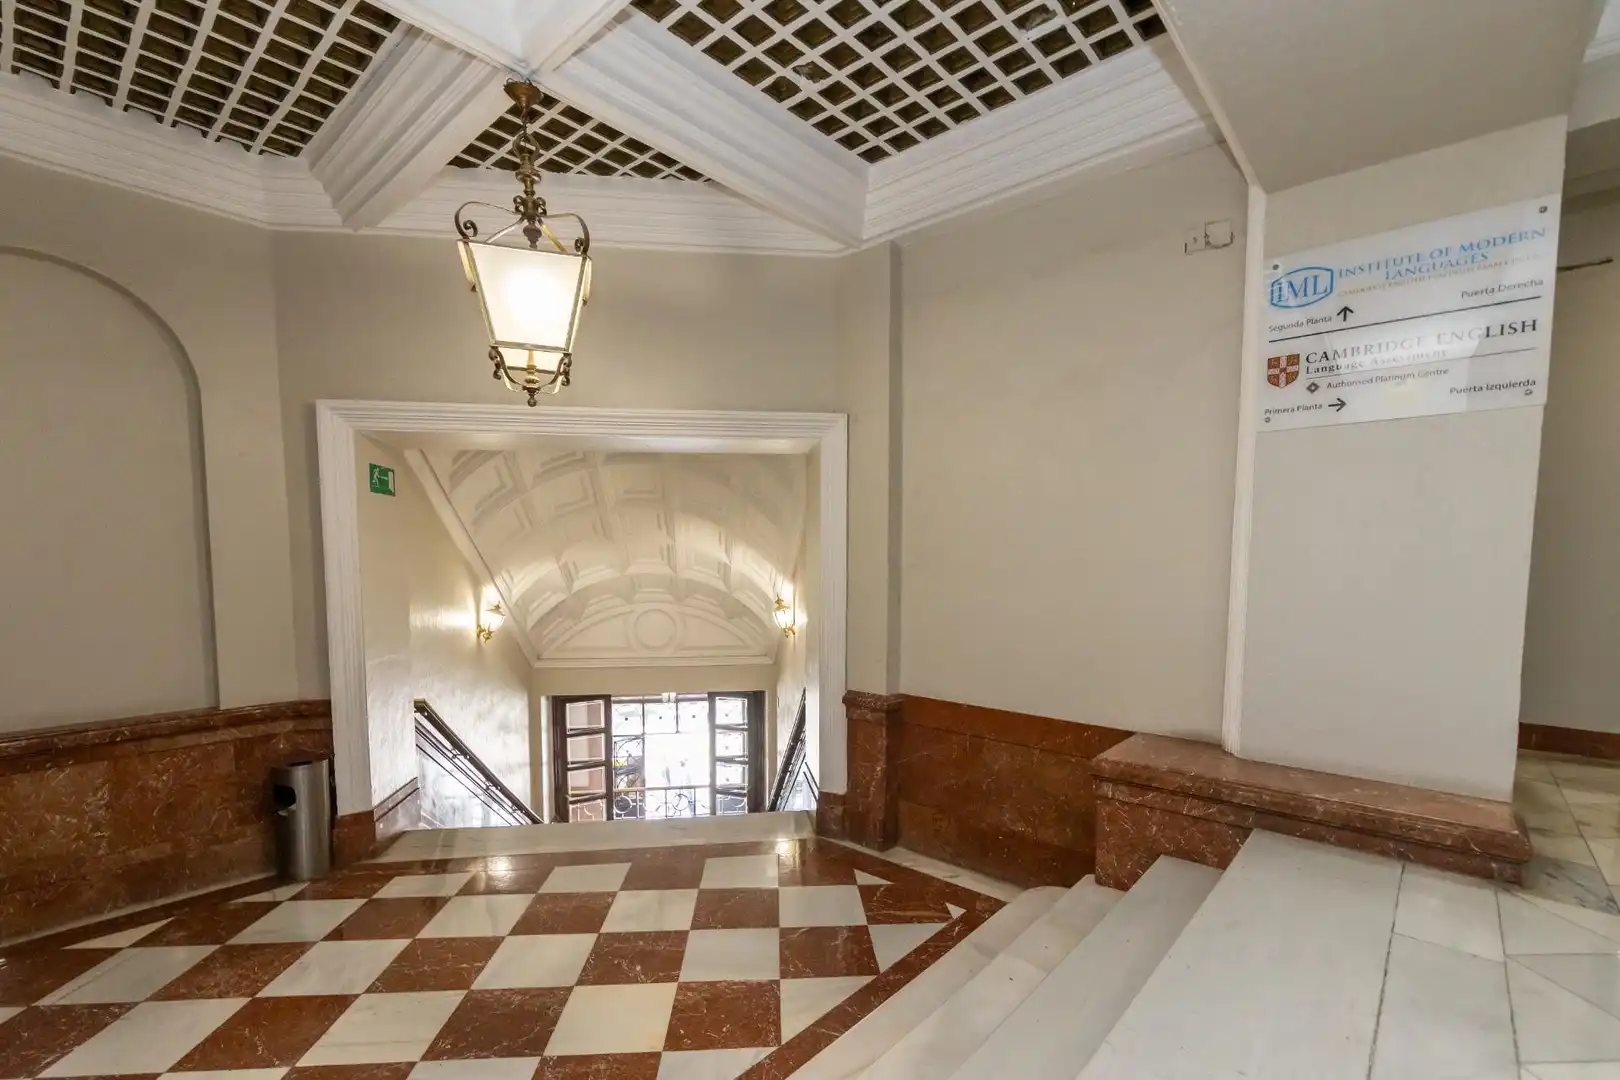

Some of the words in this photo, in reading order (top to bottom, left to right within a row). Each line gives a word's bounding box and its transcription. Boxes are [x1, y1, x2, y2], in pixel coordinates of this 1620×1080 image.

[1339, 252, 1421, 278] INSTITUTE
[1429, 246, 1452, 260] OF
[1459, 227, 1545, 252] MODERN
[1385, 252, 1488, 280] LANGUAGES
[1461, 287, 1495, 299] Puerta
[1498, 279, 1544, 293] Derecha
[1268, 320, 1304, 332] Segunda
[1306, 316, 1332, 327] Planta
[1305, 336, 1425, 364] CAMBRIDGE
[1437, 319, 1538, 345] ENGLISH
[1326, 377, 1373, 389] Authorised
[1375, 372, 1415, 384] Platinum
[1417, 367, 1450, 379] Centre
[1449, 384, 1483, 395] Puerta
[1486, 379, 1536, 392] Izquierda
[1264, 405, 1295, 415] Primera
[1296, 402, 1323, 412] Planta
